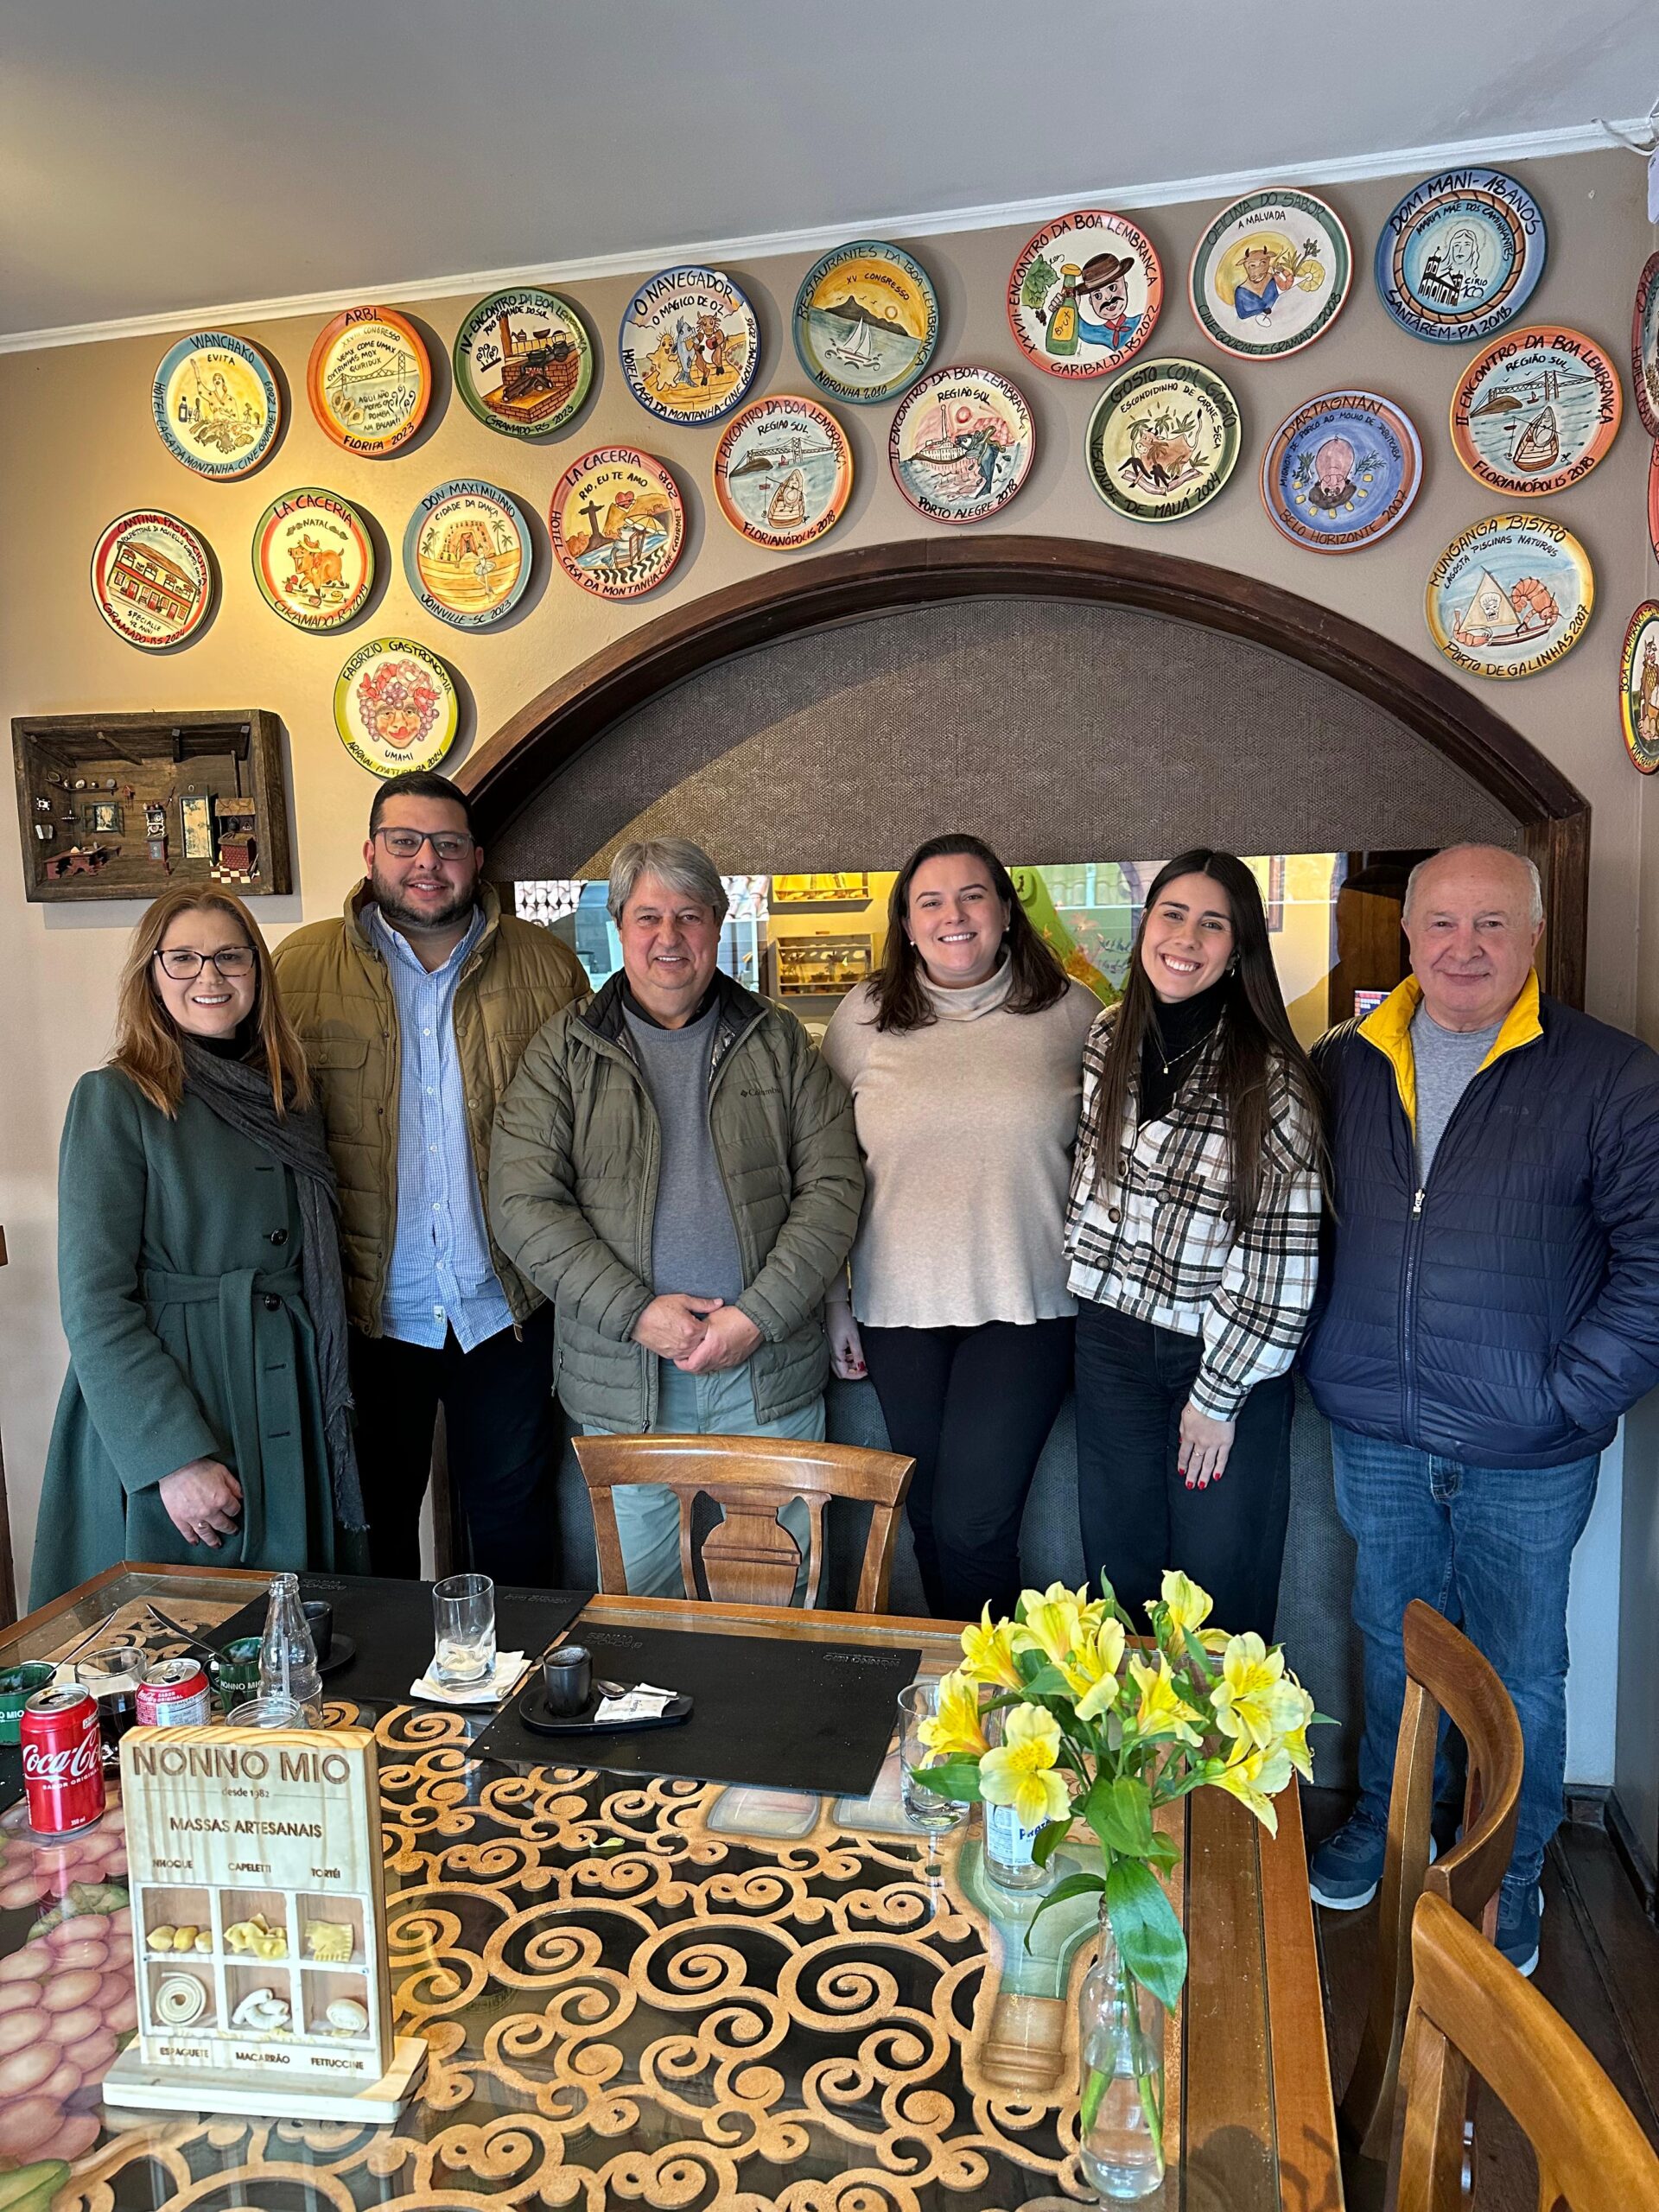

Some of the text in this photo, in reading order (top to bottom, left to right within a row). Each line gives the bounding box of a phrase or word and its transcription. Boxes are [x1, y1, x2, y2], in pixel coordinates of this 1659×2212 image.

[1246, 211, 1286, 225] MALVADA
[1260, 192, 1325, 222] DO SABOR
[1390, 192, 1423, 236] DOM
[1416, 212, 1441, 236] MARIA
[1443, 200, 1462, 216] MÃE
[1482, 207, 1515, 261] CAMINHANTES
[1051, 214, 1158, 287] DA BOA LEMBRANÇA
[634, 270, 733, 315] O NAVEGADOR
[847, 273, 910, 301] XV CONGRESSO
[1461, 287, 1484, 298] 100
[346, 308, 383, 326] ARBL
[519, 295, 554, 312] DA BOA
[659, 296, 724, 319] MÁGICO DE OZ
[798, 245, 936, 366] RESTAURANTES DA BOA LEMBRANÇA
[484, 321, 496, 336] RIO
[496, 306, 525, 321] GRANDE
[536, 308, 549, 320] SUL
[1138, 304, 1159, 339] 2022
[1480, 306, 1512, 332] 2018
[190, 334, 254, 363] WANCHAKO
[357, 340, 374, 351] COME
[364, 327, 400, 341] CONGRESSO
[207, 354, 235, 365] EVITA
[1505, 353, 1546, 372] REGIÃO
[622, 341, 756, 416] HOTEL CASA DA GOURMET
[816, 371, 887, 399] NORONHA 2010
[1460, 343, 1517, 409] ENCONTRO
[1524, 335, 1544, 349] DA
[1551, 335, 1582, 355] BOA
[1581, 350, 1614, 424] LEMBRANÇA
[891, 368, 980, 445] ENCONTRO DA BOA
[973, 389, 991, 404] SUL
[1111, 363, 1238, 429] GOSTO COM GOSTO
[154, 382, 276, 460] HOTEL CASA DA GOURMET
[552, 404, 574, 425] 2023
[791, 422, 809, 434] SUL
[1121, 383, 1222, 449] ESCONDIDINHO DE CARNE SECA
[344, 435, 384, 451] FLORIPA
[391, 422, 414, 445] 2023
[721, 400, 846, 470] ENCONTRO DA BOA LEMBRANÇA
[1280, 412, 1401, 487] MIGNON PORCO AO MOLHO DE JABUTICABA
[565, 450, 641, 486] LA CACERIA
[597, 474, 608, 486] EU
[626, 474, 648, 487] AMO
[1091, 435, 1221, 516] VISCONDE DE 2004
[1473, 456, 1595, 493] FLORIANÓPOLIS 2018
[274, 494, 353, 528] LA CACERIA
[421, 483, 515, 518] DON MAXIMILIANO
[435, 501, 461, 521] CIDADE
[478, 501, 499, 518] DANÇA
[918, 479, 1018, 519] PORTO ALEGRE 2018
[118, 514, 160, 533] CANTINA
[303, 518, 329, 530] NATAL
[743, 510, 836, 546] FLORIANÓPOLIS 2018
[1280, 489, 1408, 544] BELO HORIZONTE 2007
[550, 511, 599, 591] HOTEL CASA DA
[1430, 515, 1569, 588] MUNGANGA BISTRÔ
[1445, 536, 1558, 589] LAGOSTA PISCINAS NATURAIS
[128, 610, 161, 632] SPECIALLE
[421, 594, 512, 624] JOINVILLE 2023
[165, 629, 185, 644] 2024
[1444, 605, 1590, 676] PORTO DE GALINHAS 2007
[343, 641, 452, 695] FABRIZIO GASTRONOMIA
[346, 741, 442, 767] ARRAIAL 2024
[385, 750, 413, 761] UMAMI
[220, 1681, 245, 1690] NONNO
[7, 1710, 24, 1719] MIO
[132, 1746, 350, 1784] NONNO MIO
[222, 1786, 270, 1799] desde 1982
[170, 1817, 322, 1839] MASSAS ARTESANAIS
[228, 1862, 271, 1873] CAPELETTI
[160, 2047, 209, 2058] ESPAGUETE
[235, 2050, 290, 2064] MACARRÃO
[311, 2057, 364, 2070] FETTUCCINE
